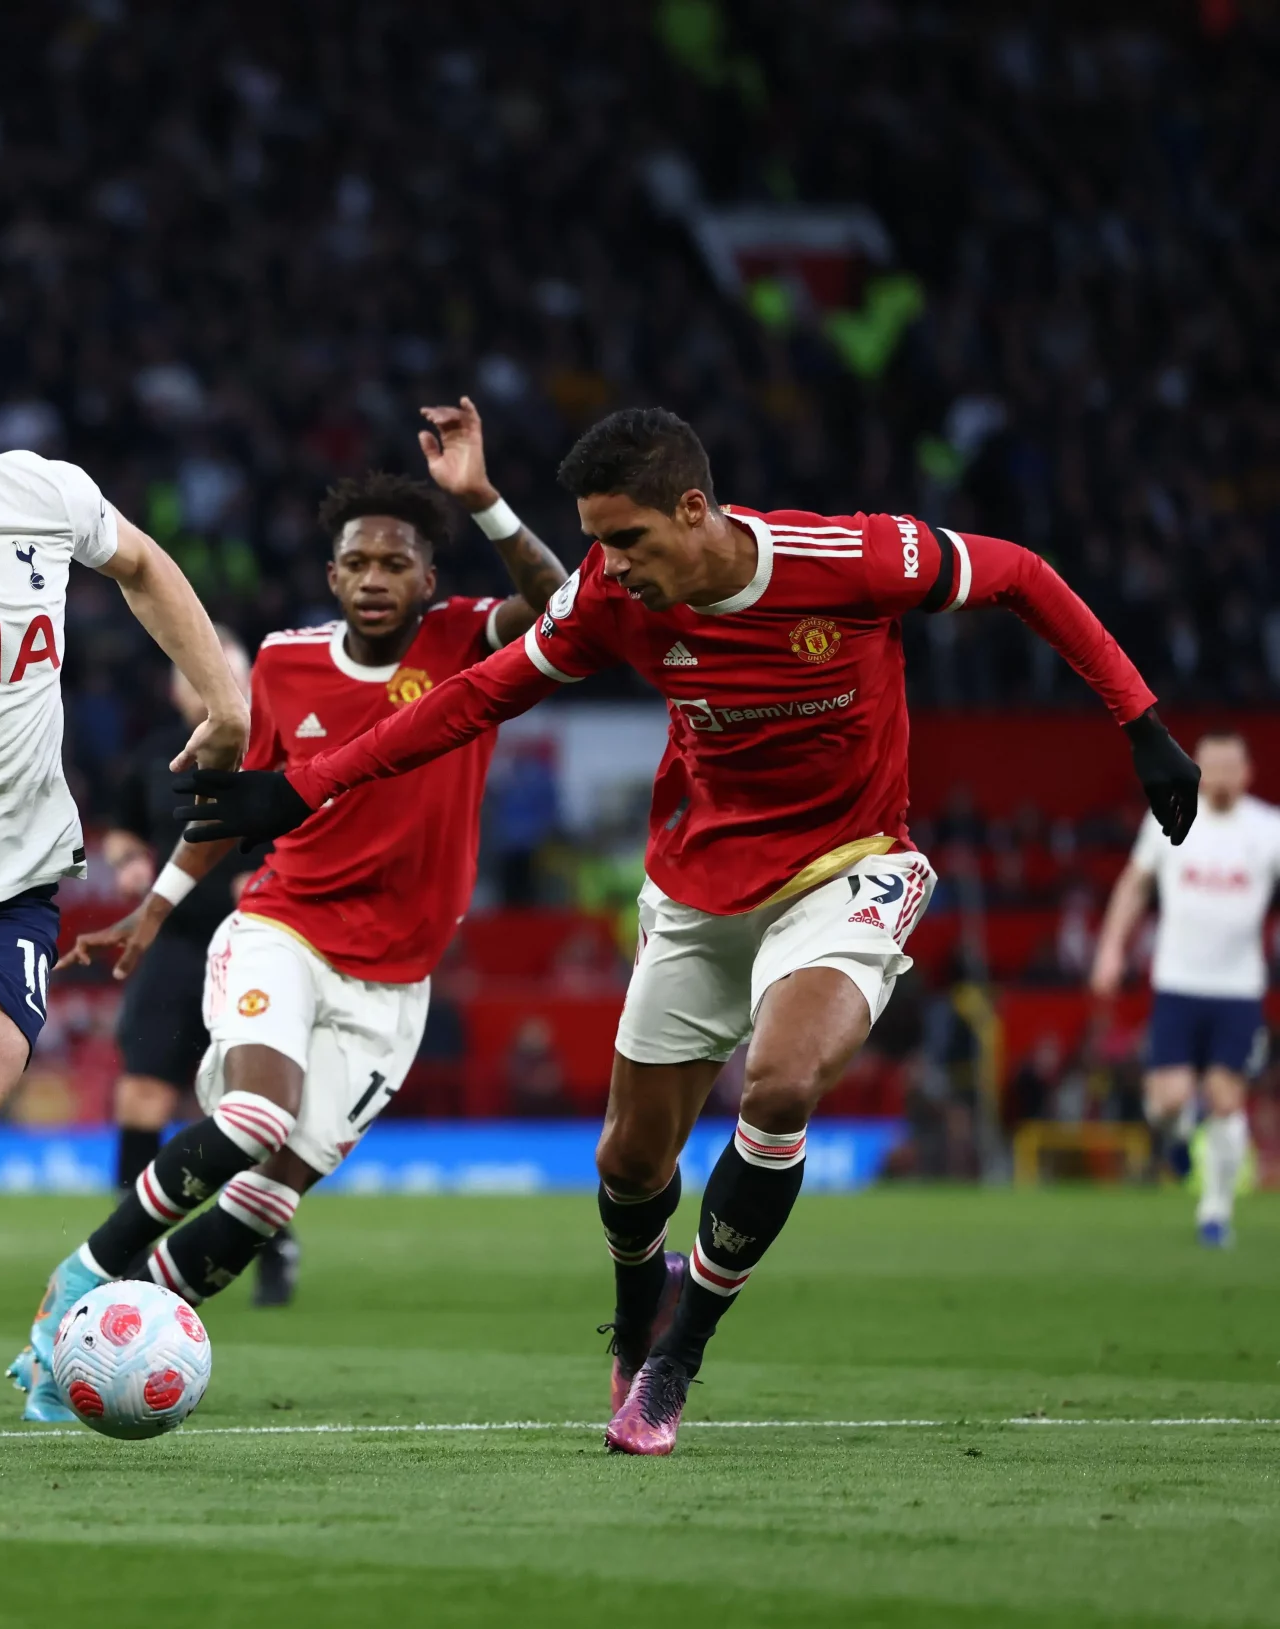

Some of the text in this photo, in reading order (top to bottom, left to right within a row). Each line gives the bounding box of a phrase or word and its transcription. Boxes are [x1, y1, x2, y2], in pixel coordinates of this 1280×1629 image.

[890, 515, 919, 578] KOHL
[793, 619, 833, 641] MANCHESTER
[663, 655, 698, 666] adidas
[807, 647, 835, 661] UNITED
[715, 688, 857, 723] TeamViewer
[848, 916, 885, 929] adidas
